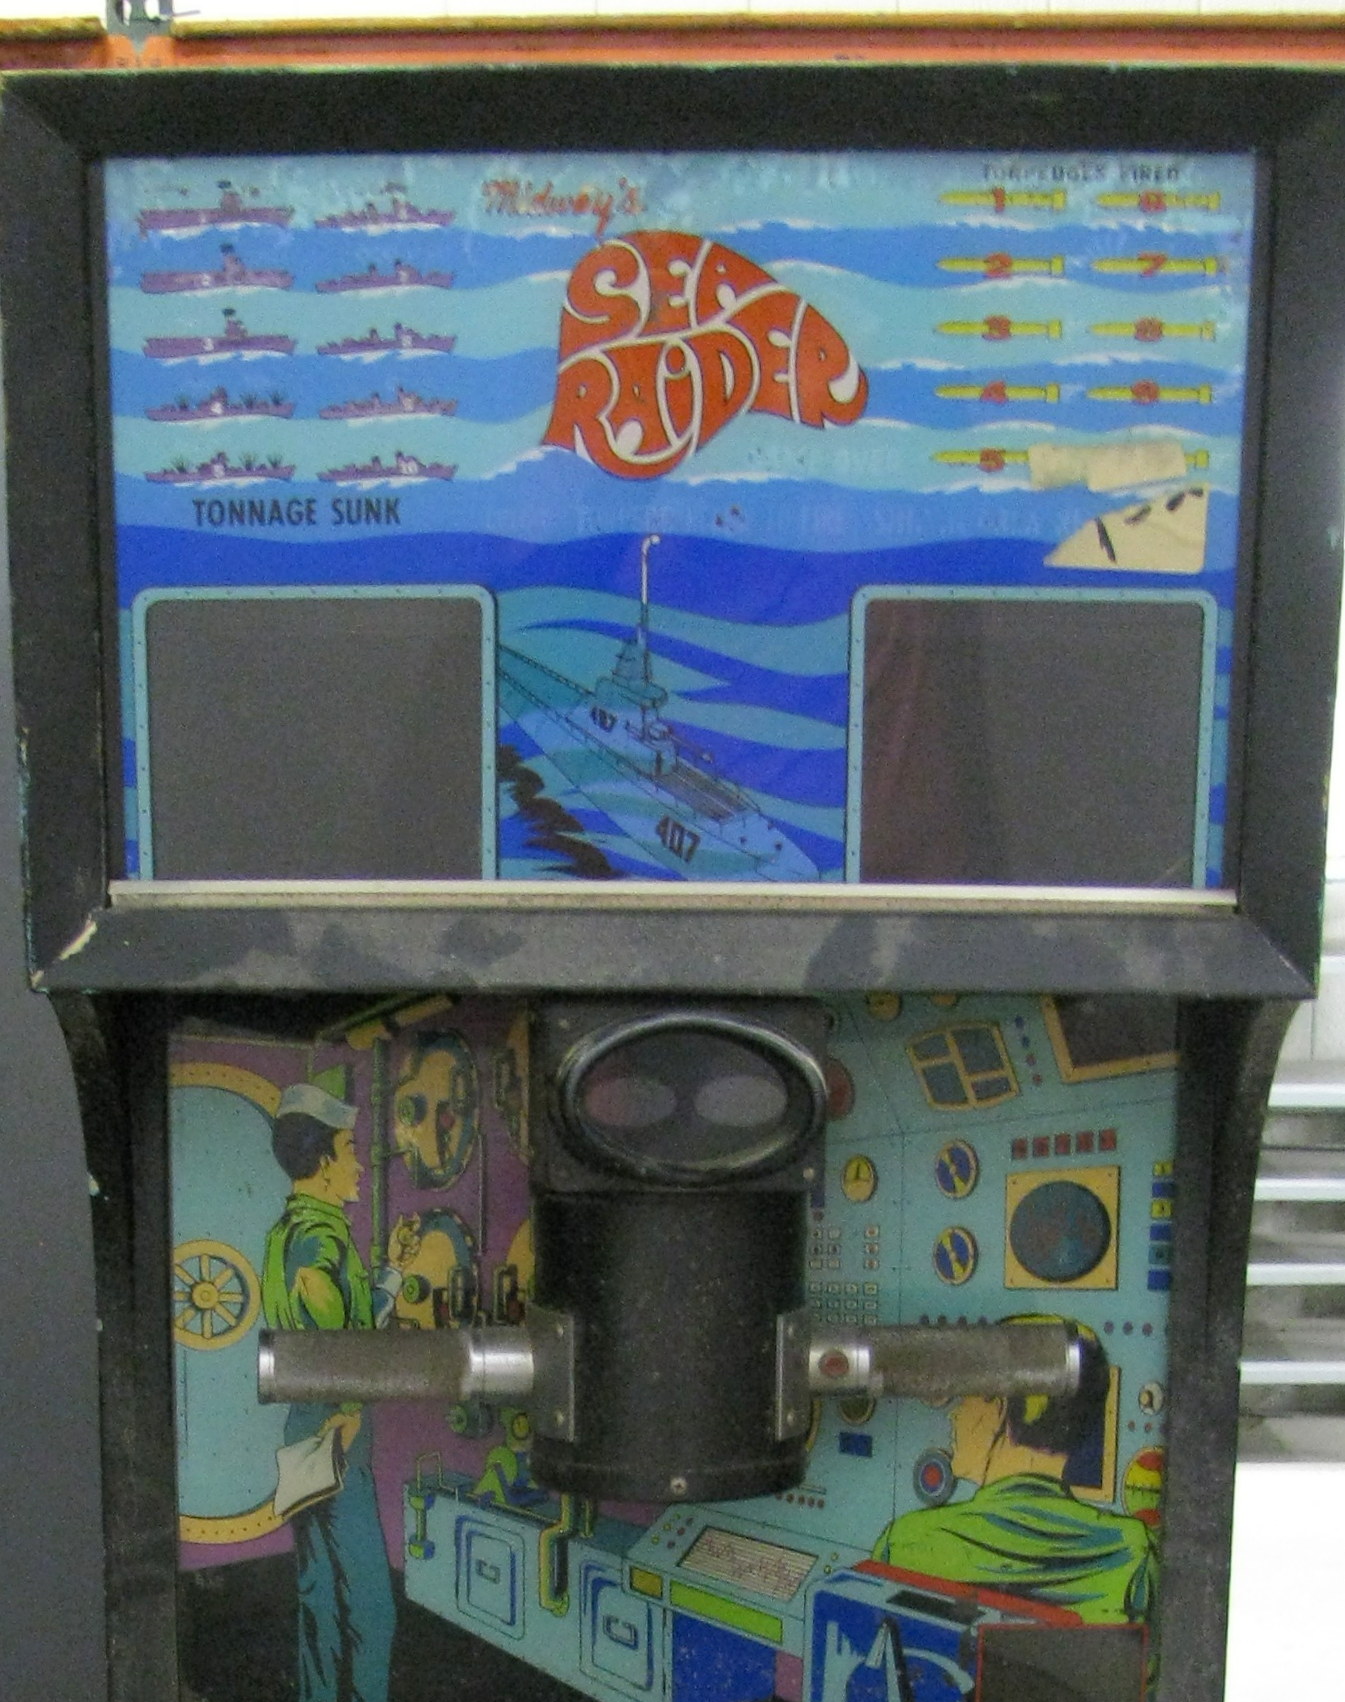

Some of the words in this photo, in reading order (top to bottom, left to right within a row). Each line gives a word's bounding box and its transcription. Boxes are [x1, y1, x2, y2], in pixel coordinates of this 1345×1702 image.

[992, 187, 1006, 213] 1
[984, 252, 1012, 279] 2
[1137, 253, 1168, 278] 7
[560, 231, 782, 364] SEA
[541, 286, 870, 480] RAIDER
[192, 498, 317, 527] TONNAGE
[331, 498, 401, 525] SUNK
[657, 816, 701, 863] 407
